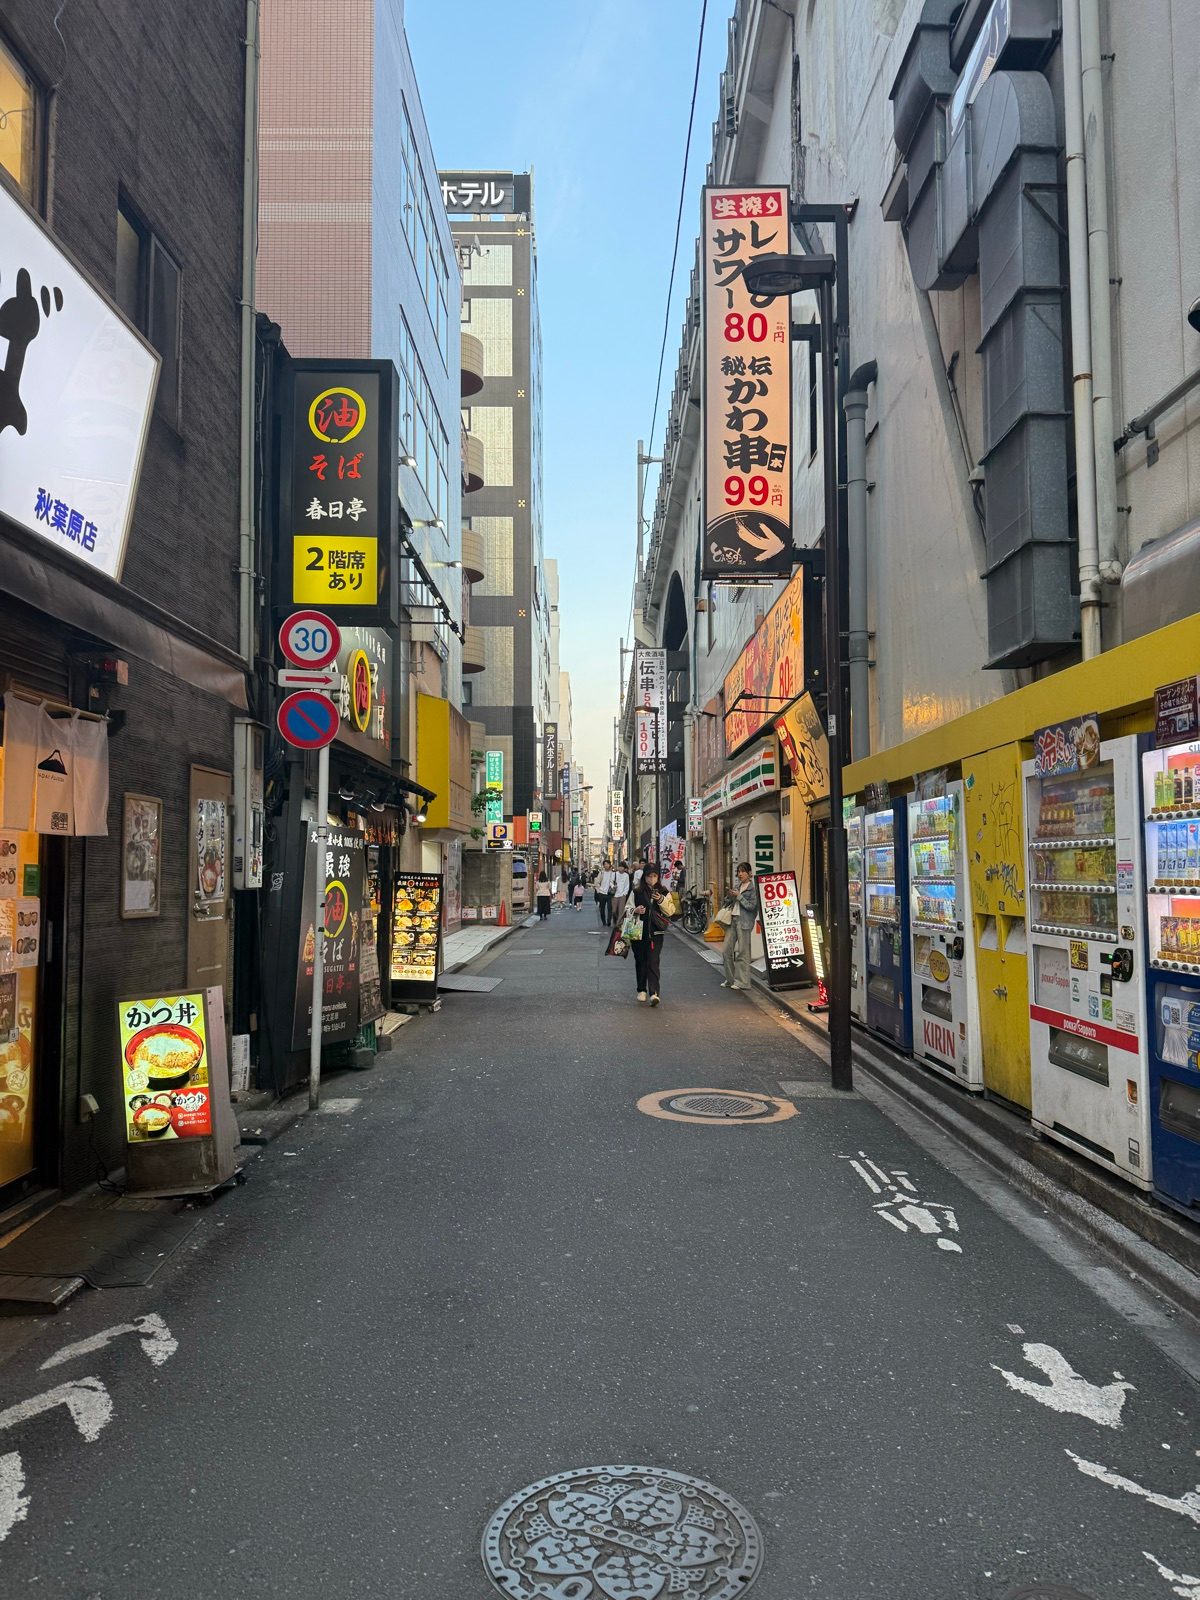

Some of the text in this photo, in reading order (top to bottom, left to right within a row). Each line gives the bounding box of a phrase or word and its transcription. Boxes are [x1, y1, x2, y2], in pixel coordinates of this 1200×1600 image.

[440, 181, 505, 207] ホテル
[714, 195, 779, 218] 生搾り
[712, 228, 747, 310] サワー
[723, 312, 768, 343] 80
[720, 356, 773, 377] 秘伝
[317, 397, 359, 434] 油
[723, 378, 771, 475] かわ串
[308, 452, 365, 481] そば
[724, 475, 769, 507] 99
[34, 487, 99, 553] 秋葉原店
[304, 497, 368, 522] 春日亭
[305, 546, 367, 571] 2階席
[328, 572, 364, 591] あり
[294, 627, 328, 654] 30
[639, 660, 656, 691] 伝串
[640, 722, 648, 752] 190
[650, 718, 662, 757] 生ビル
[546, 734, 555, 769] アパホテル
[612, 806, 623, 815] 50
[325, 851, 351, 879] 最強
[761, 873, 792, 883] オールタイム
[763, 882, 788, 901] 80
[324, 891, 345, 927] 油
[783, 927, 797, 935] 199
[789, 946, 800, 955] 99
[323, 964, 345, 974] SUGATEI
[126, 1002, 197, 1029] かつ丼
[1063, 1018, 1077, 1030] pokka
[923, 1019, 956, 1060] KIRIN
[176, 1094, 206, 1104] かつ丼
